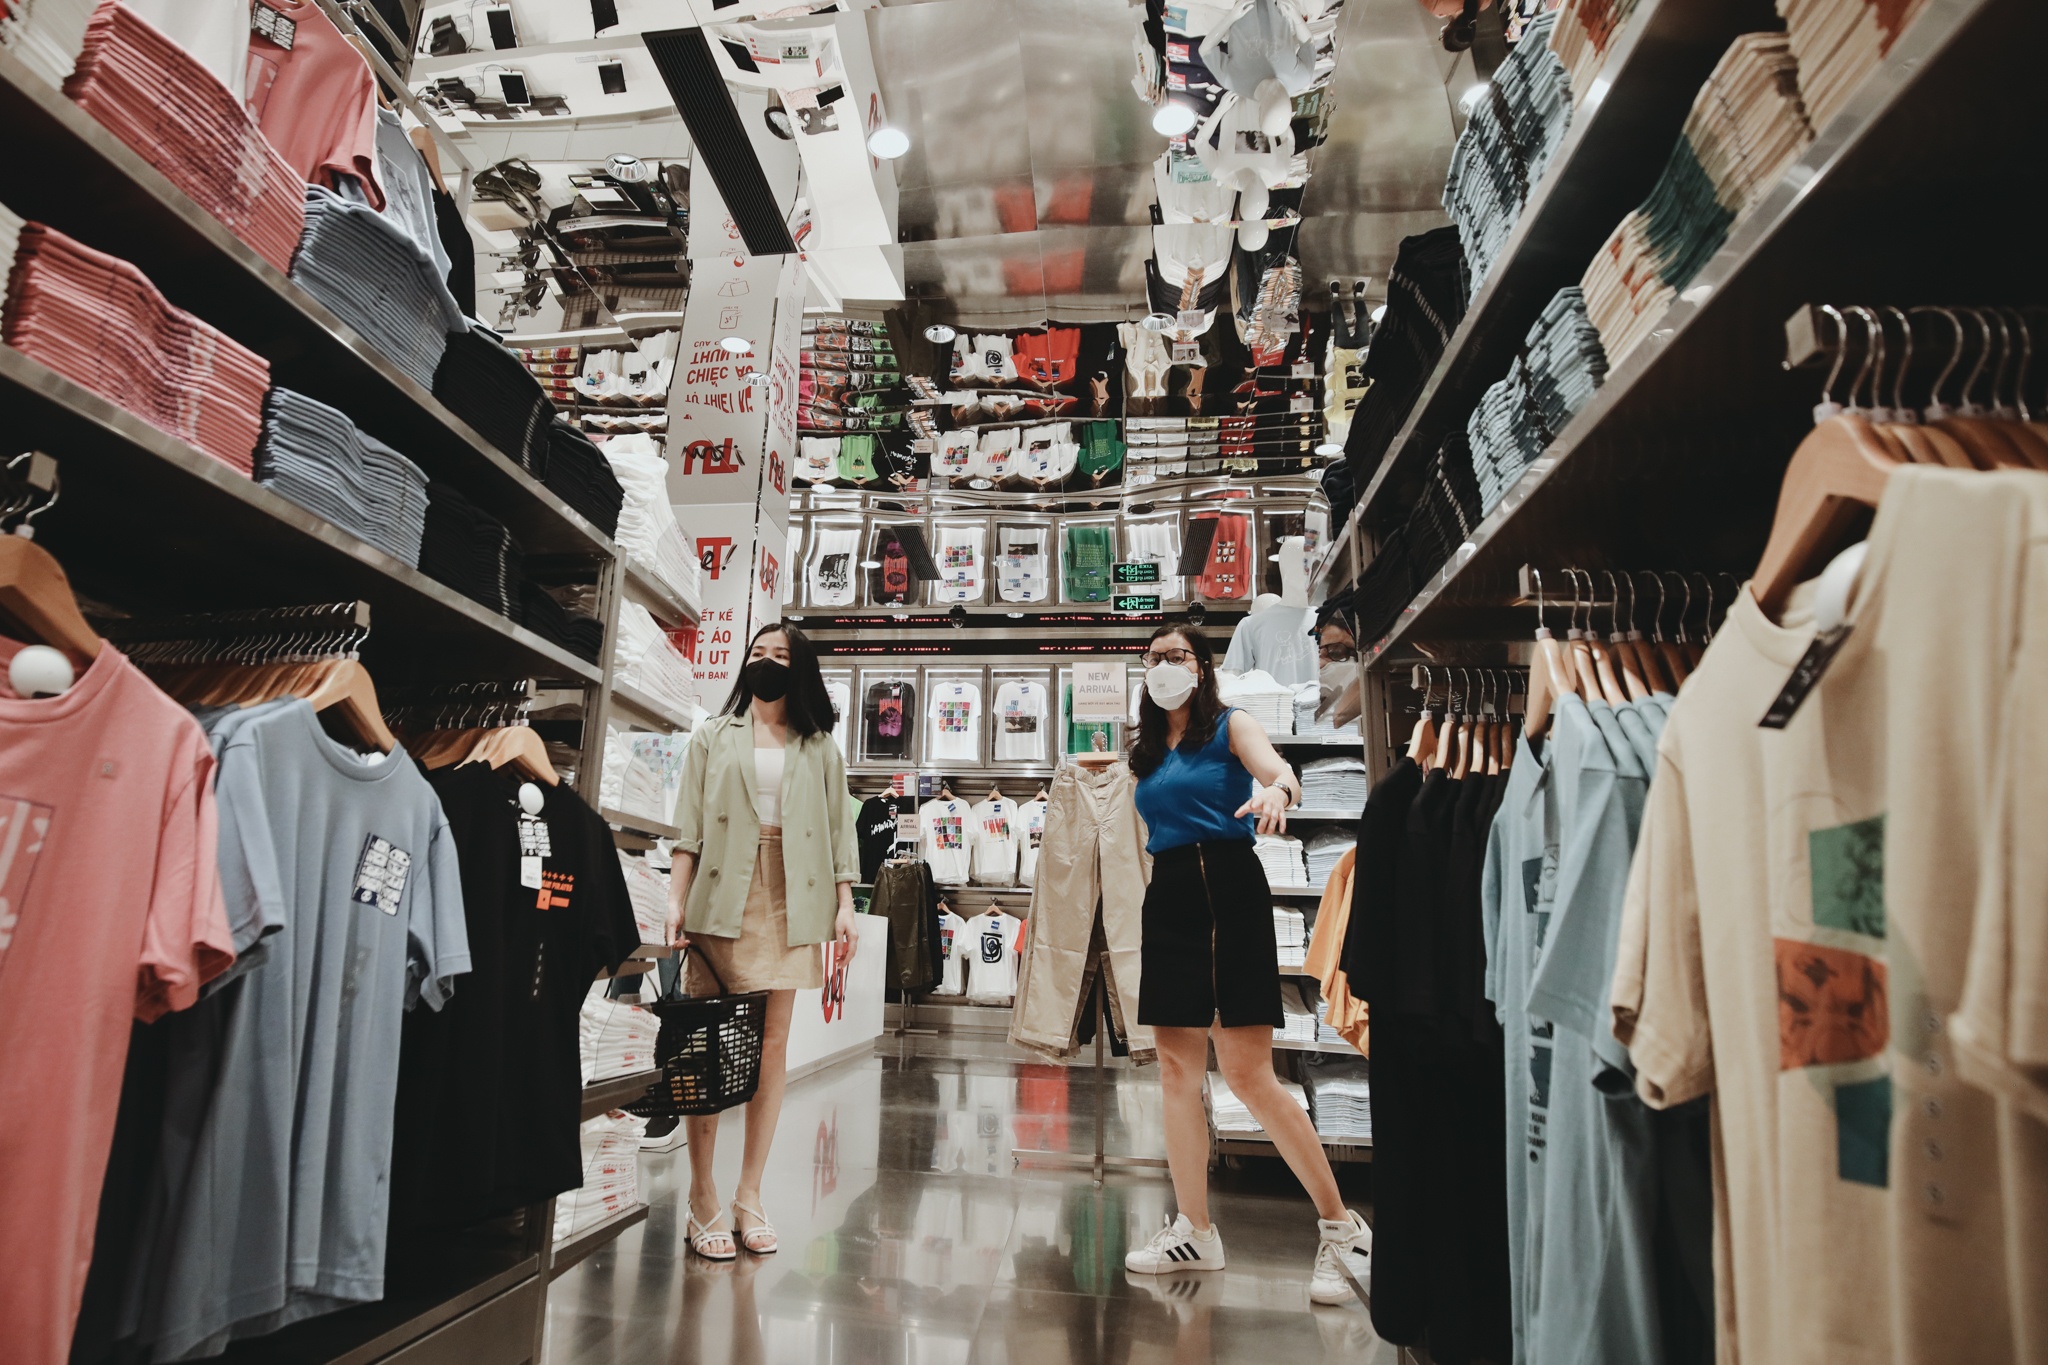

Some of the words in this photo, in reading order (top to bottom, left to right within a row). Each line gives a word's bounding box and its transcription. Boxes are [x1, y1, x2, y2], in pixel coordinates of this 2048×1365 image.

[696, 537, 733, 580] T
[759, 545, 779, 600] UT
[718, 607, 734, 622] KẾ
[711, 626, 732, 644] ÁO
[709, 650, 730, 665] UT
[708, 671, 729, 682] BẠN!
[1088, 672, 1110, 681] NEW
[1079, 684, 1120, 694] ARRIVAL
